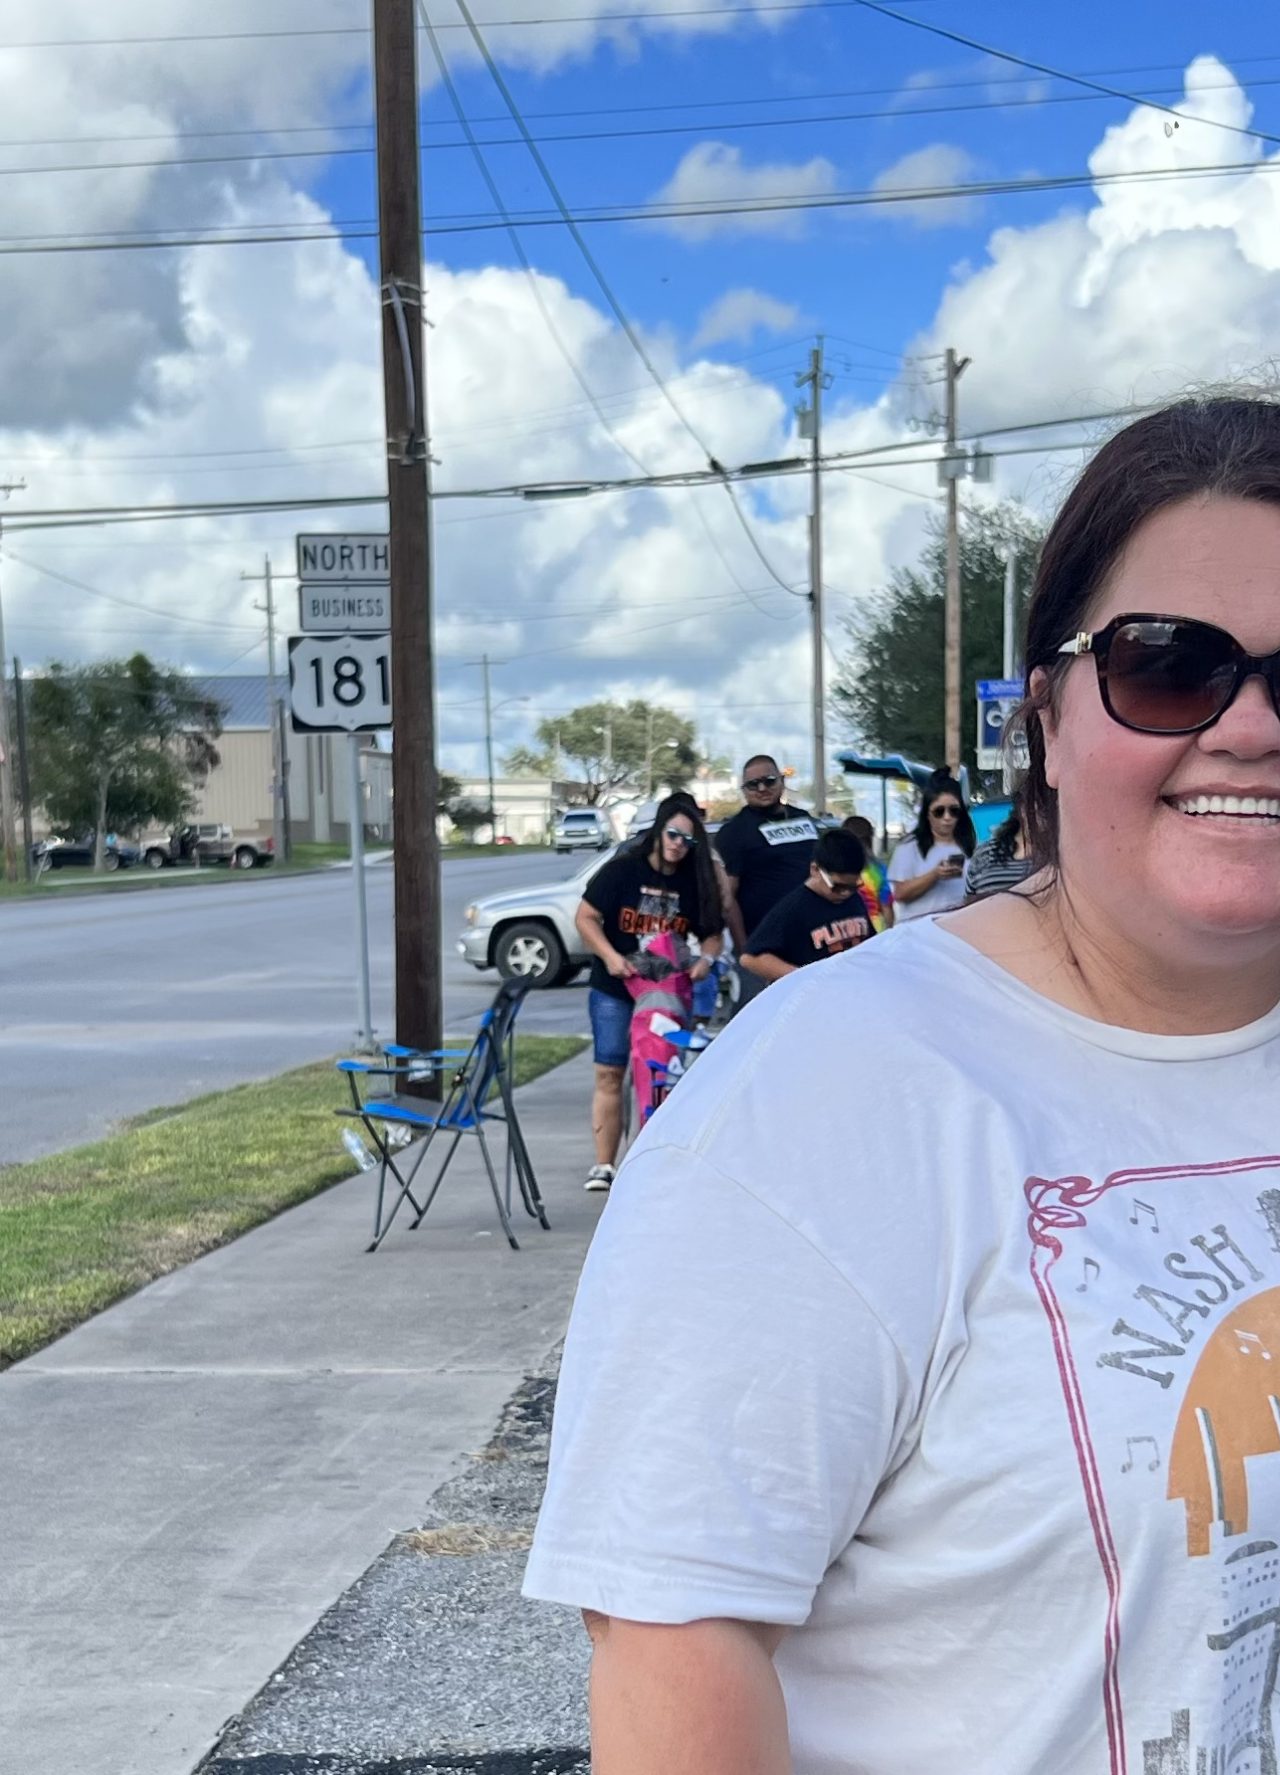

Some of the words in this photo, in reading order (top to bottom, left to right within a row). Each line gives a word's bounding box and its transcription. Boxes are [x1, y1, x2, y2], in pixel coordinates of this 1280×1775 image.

[302, 543, 389, 571] NORTH
[312, 598, 384, 618] BUSINESS
[310, 655, 390, 708] 181
